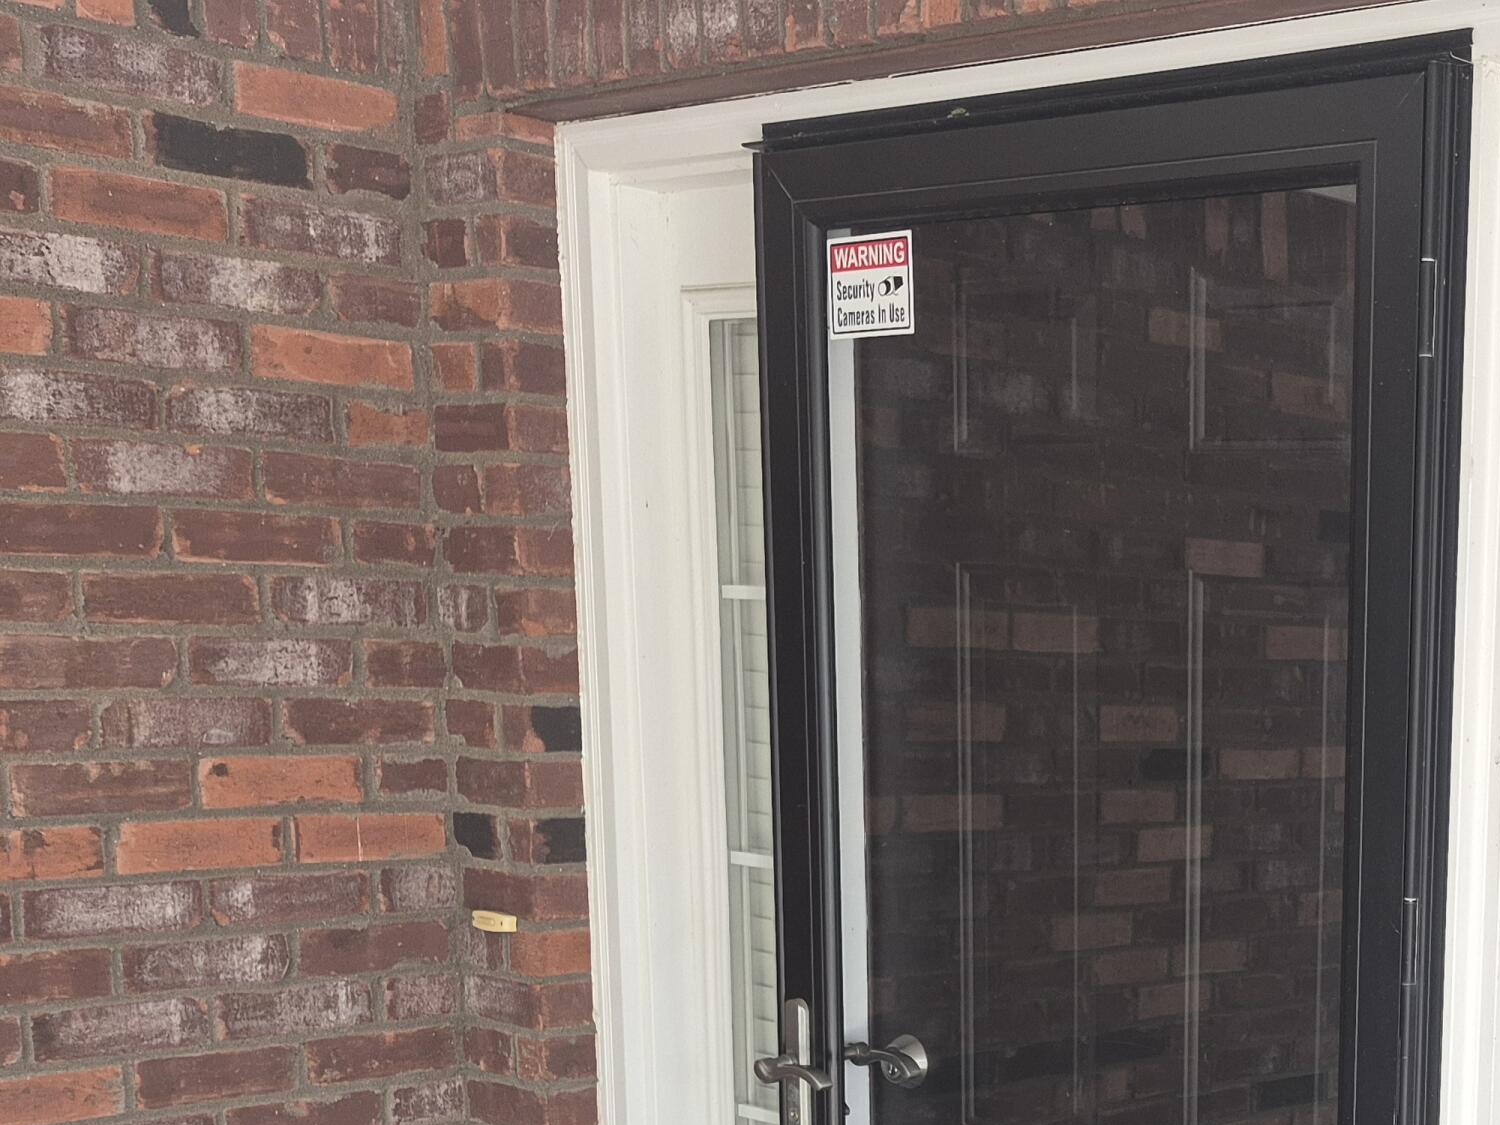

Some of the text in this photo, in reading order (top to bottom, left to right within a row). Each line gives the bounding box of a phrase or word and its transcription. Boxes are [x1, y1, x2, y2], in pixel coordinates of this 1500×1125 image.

[834, 242, 905, 269] WARNING
[836, 279, 875, 302] Security
[837, 303, 905, 327] Cameras In Use
